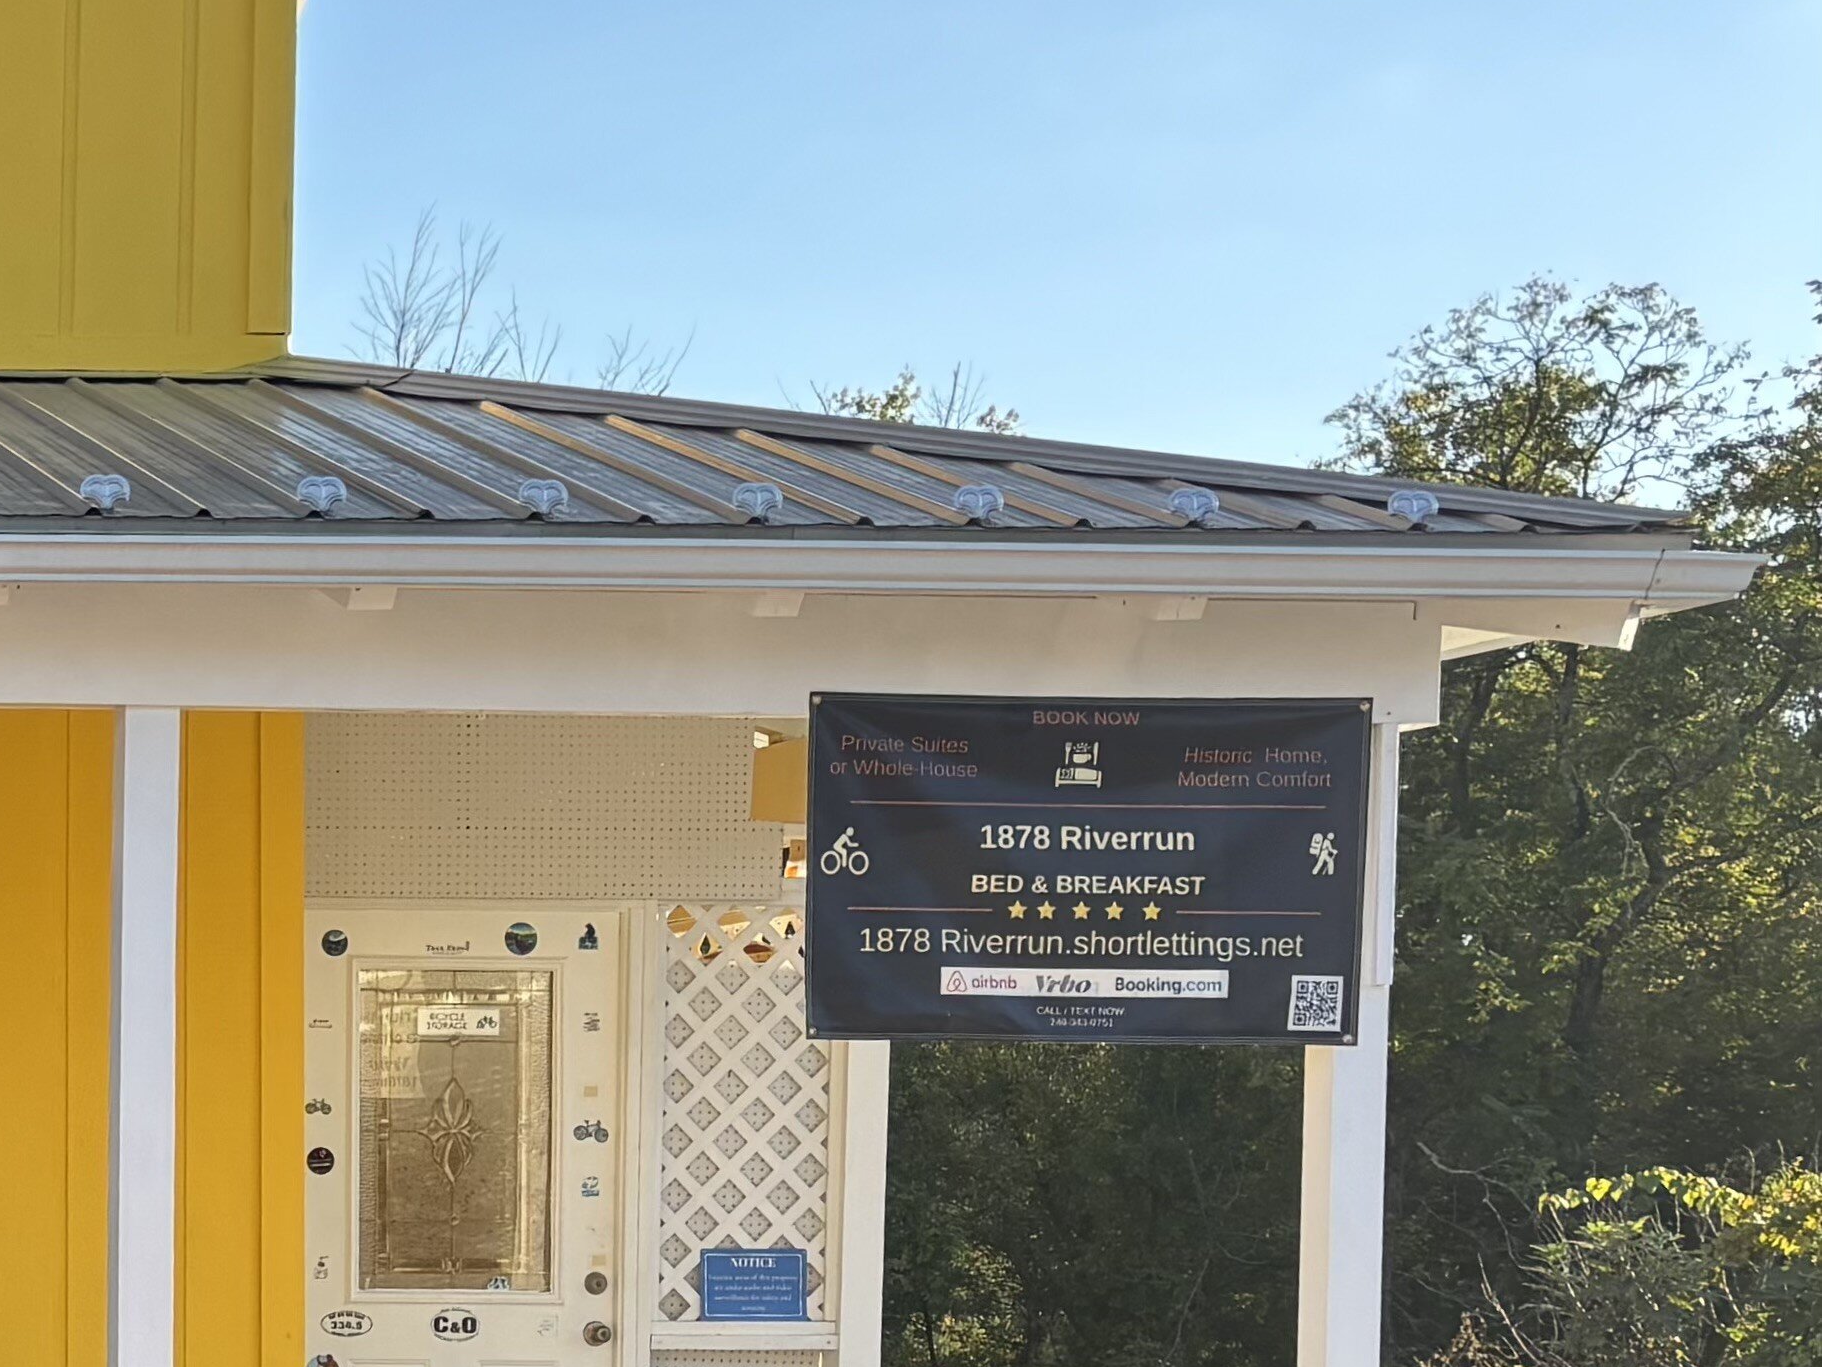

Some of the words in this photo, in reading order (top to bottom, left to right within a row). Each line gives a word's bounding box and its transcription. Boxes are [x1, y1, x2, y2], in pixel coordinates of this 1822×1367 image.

[1033, 710, 1089, 726] BOOK
[1094, 711, 1141, 726] NOW
[841, 734, 905, 752] Private
[911, 736, 969, 753] Suites
[1184, 746, 1253, 764] Historic
[1264, 746, 1328, 765] Home,
[830, 761, 848, 775] or
[853, 758, 978, 777] Whole-House
[1177, 771, 1250, 788] Modern
[1255, 771, 1332, 788] Comfort
[980, 824, 1051, 850] 1878
[1060, 825, 1196, 851] Riverrun
[971, 874, 1024, 893] BED
[1031, 875, 1049, 894] &
[1055, 874, 1206, 896] BREAKFAST
[859, 927, 931, 953] 1878
[941, 928, 1304, 962] Riverrun.shortlettings.net
[971, 975, 1018, 990] airbnb
[1035, 974, 1092, 994] Vrbo
[1114, 976, 1223, 995] Booking.com
[1036, 1006, 1062, 1015] CALL
[1071, 1006, 1095, 1015] TEXT
[1098, 1007, 1126, 1016] NOW
[731, 1257, 777, 1268] NOTICE
[433, 1316, 478, 1335] C&O
